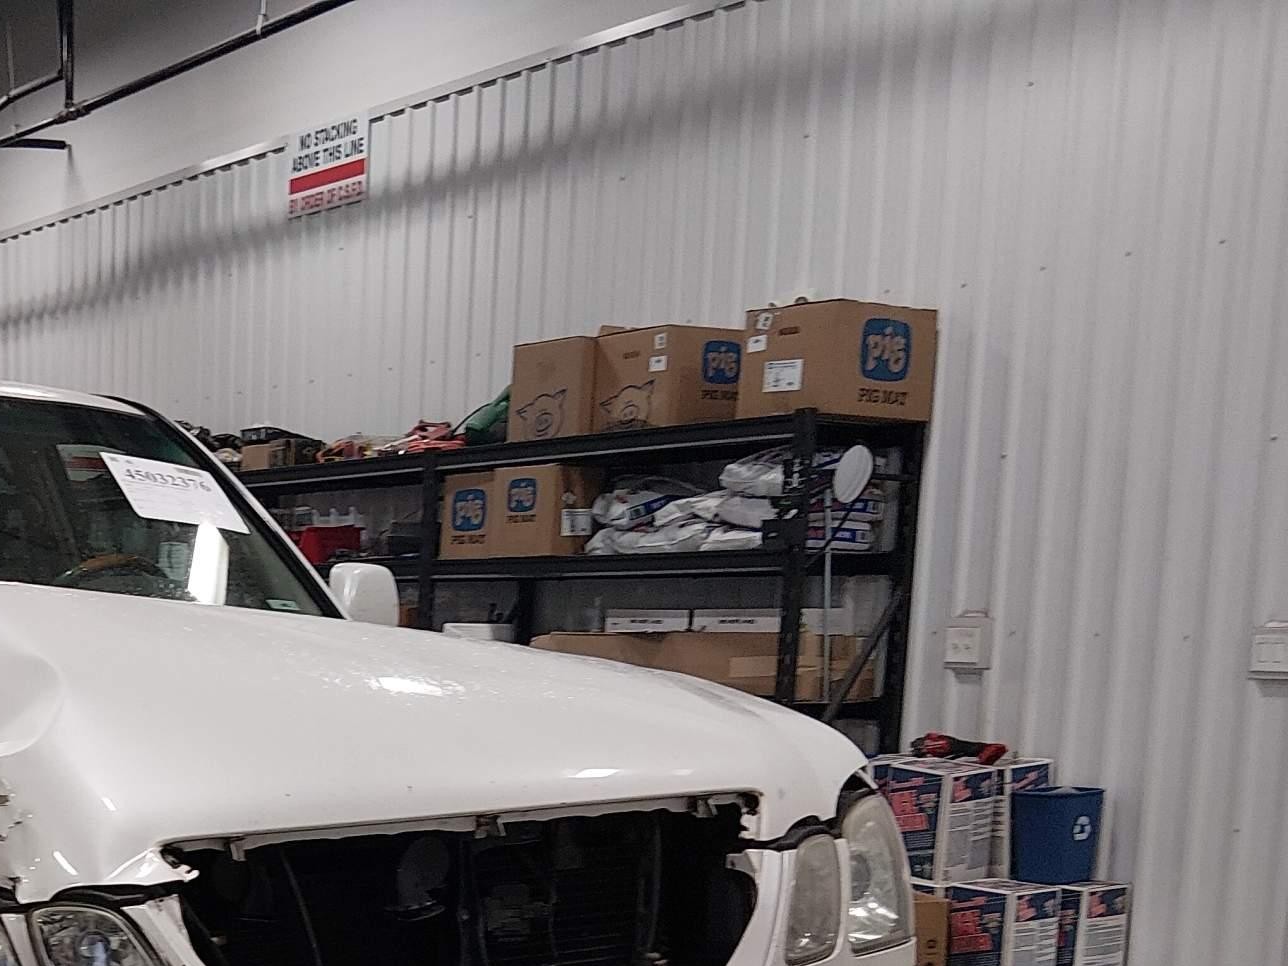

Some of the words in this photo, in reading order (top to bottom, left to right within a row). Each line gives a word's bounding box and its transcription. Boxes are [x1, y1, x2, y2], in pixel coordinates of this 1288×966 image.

[299, 133, 312, 151] NO
[314, 119, 358, 146] STACKING
[292, 151, 320, 171] ABOVE
[323, 144, 343, 164] THIS
[344, 137, 364, 158] LINE
[858, 388, 880, 403] PIG
[881, 390, 908, 406] MAT
[125, 468, 212, 492] 45032376
